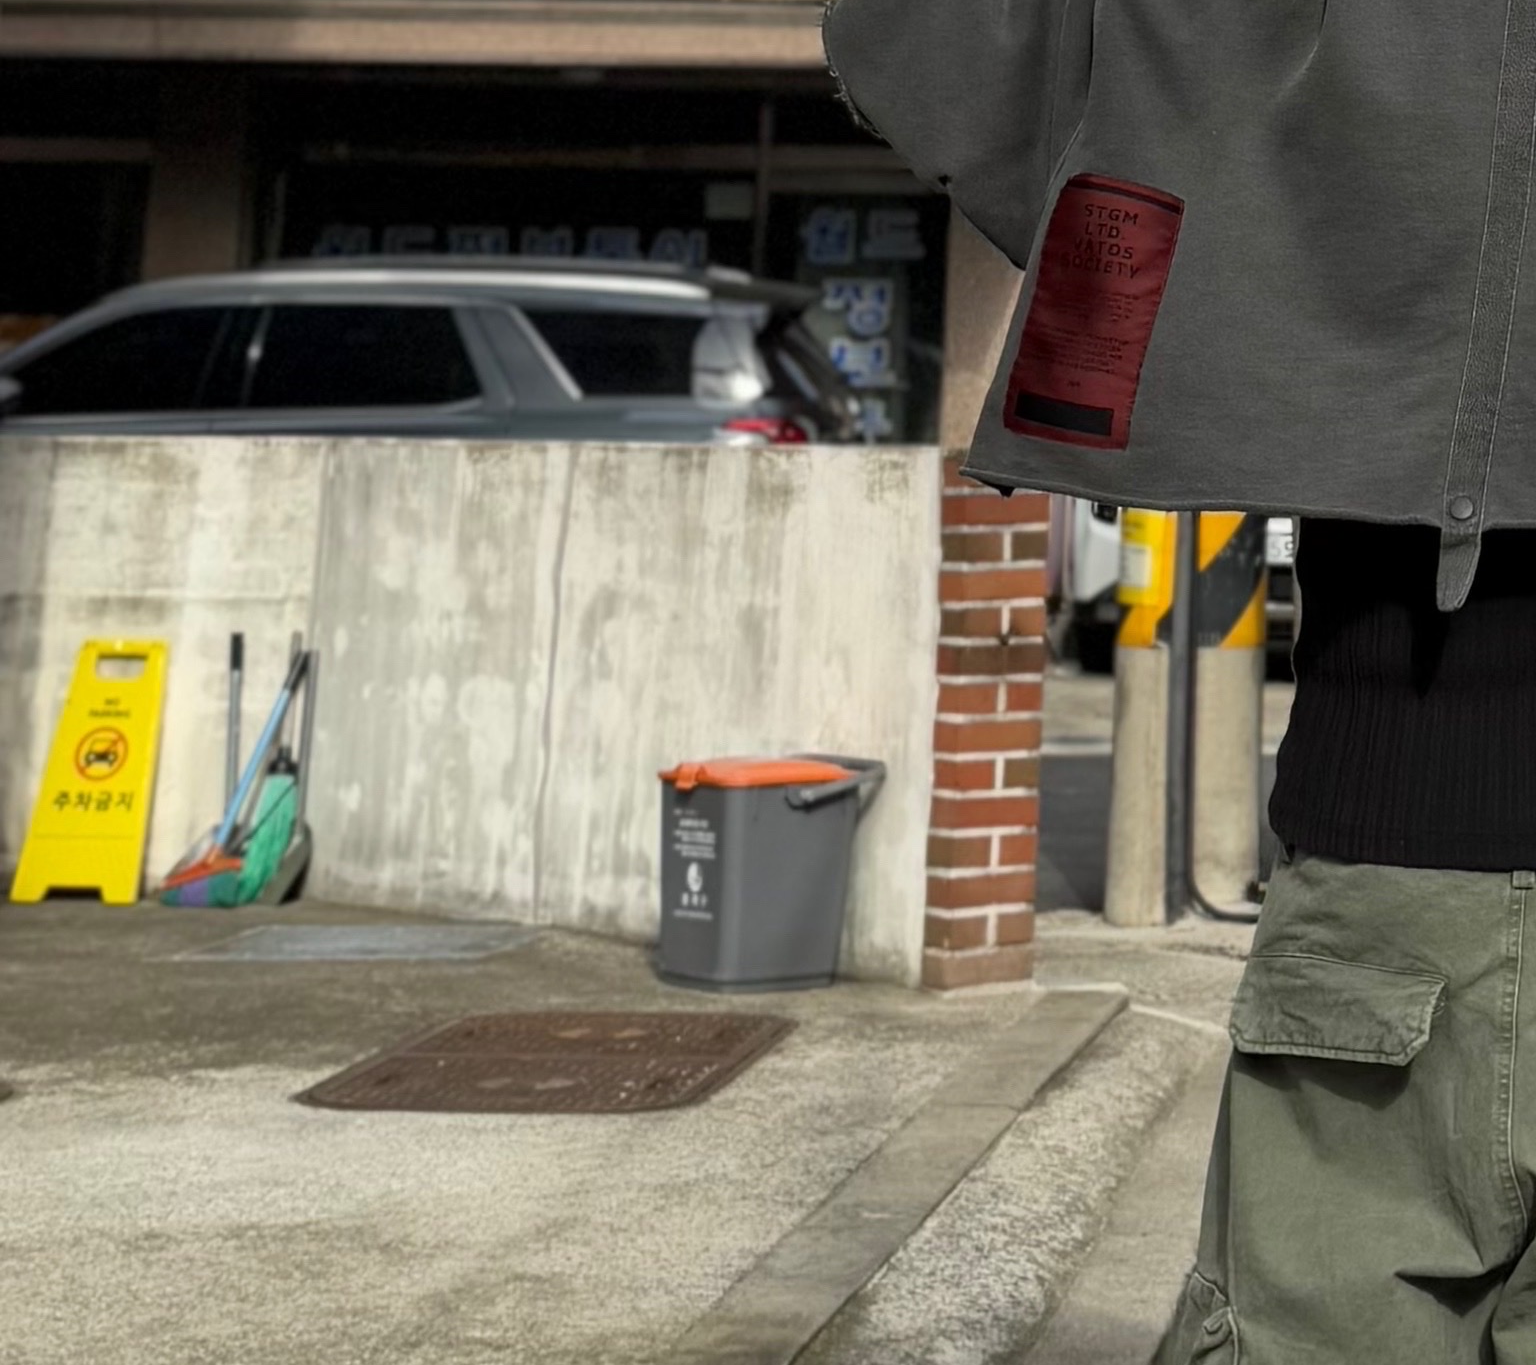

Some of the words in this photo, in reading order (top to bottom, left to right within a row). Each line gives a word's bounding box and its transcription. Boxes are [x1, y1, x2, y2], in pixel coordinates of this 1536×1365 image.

[1084, 203, 1140, 226] STGM
[1074, 237, 1134, 261] VATOS
[1061, 252, 1141, 279] SOCIETY
[53, 790, 134, 812] 주차금지
